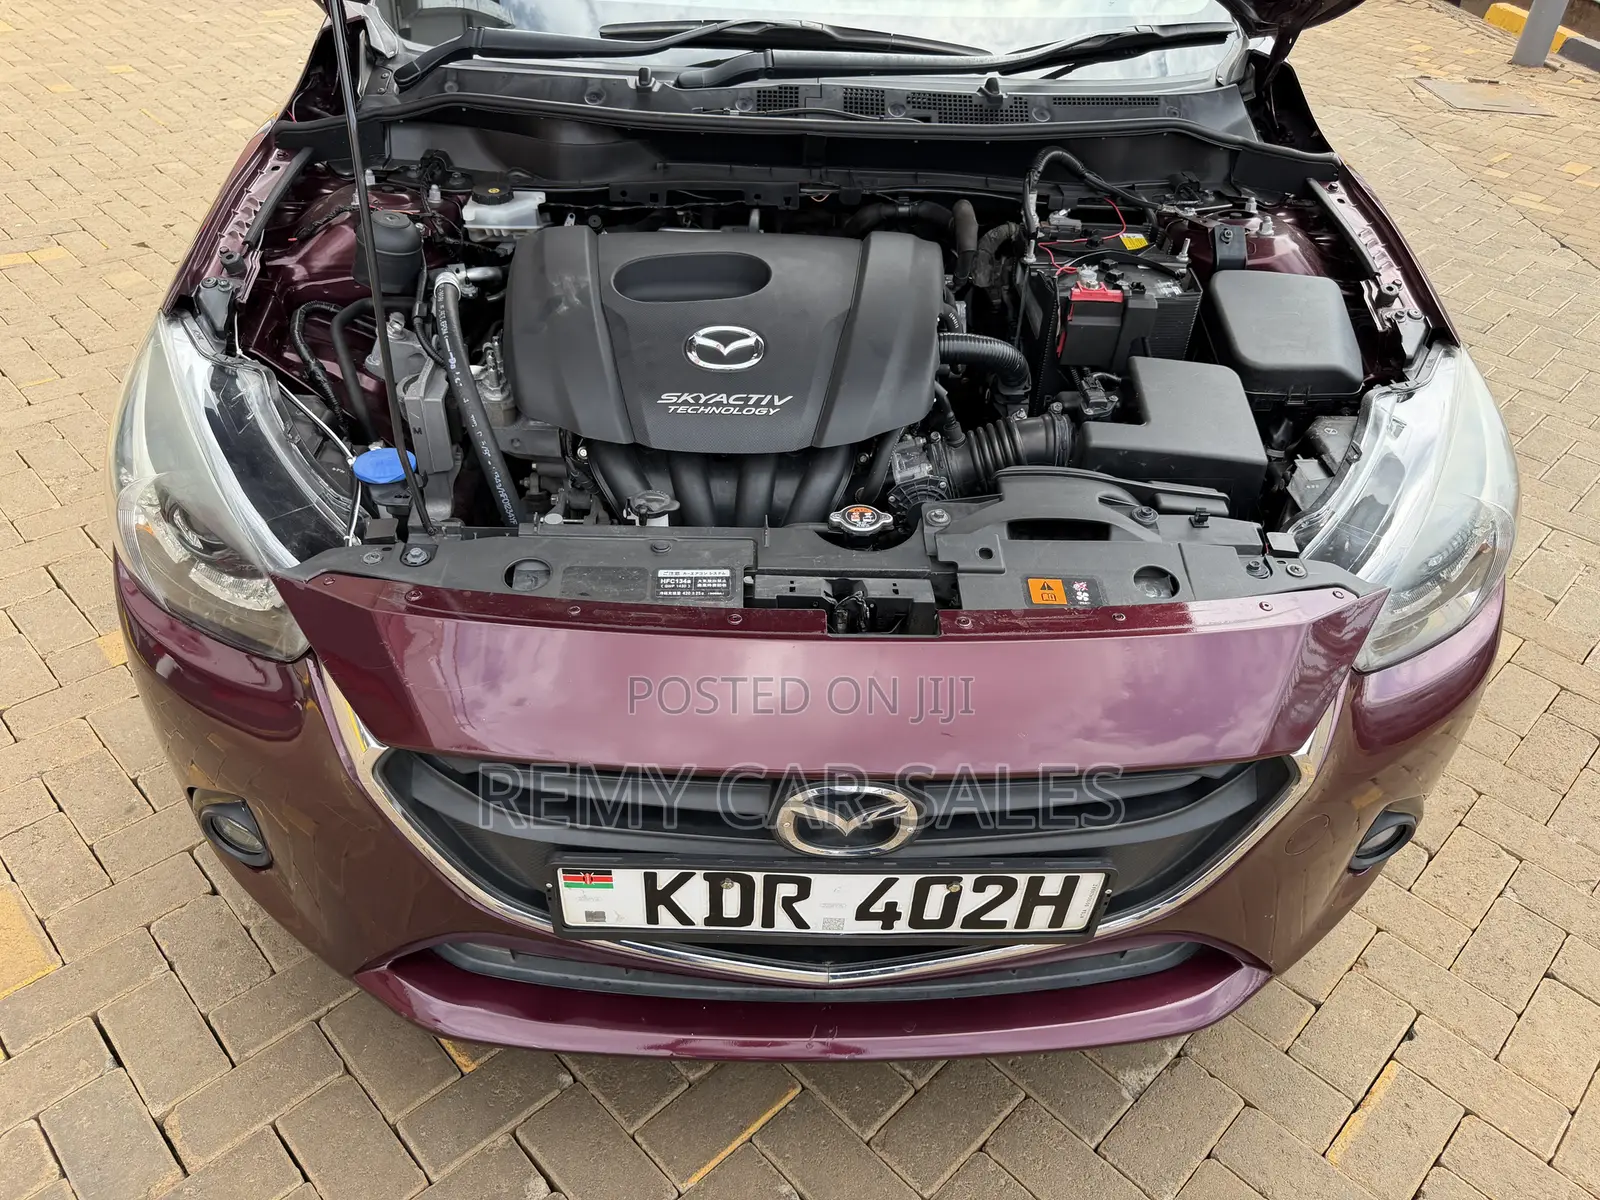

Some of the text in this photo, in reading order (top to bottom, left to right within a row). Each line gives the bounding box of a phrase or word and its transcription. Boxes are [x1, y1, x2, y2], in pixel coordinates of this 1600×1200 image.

[657, 392, 793, 406] SKYACTIV
[668, 405, 781, 416] TECHNOLOGY
[643, 871, 812, 930] KDR
[855, 875, 1080, 930] 402H
